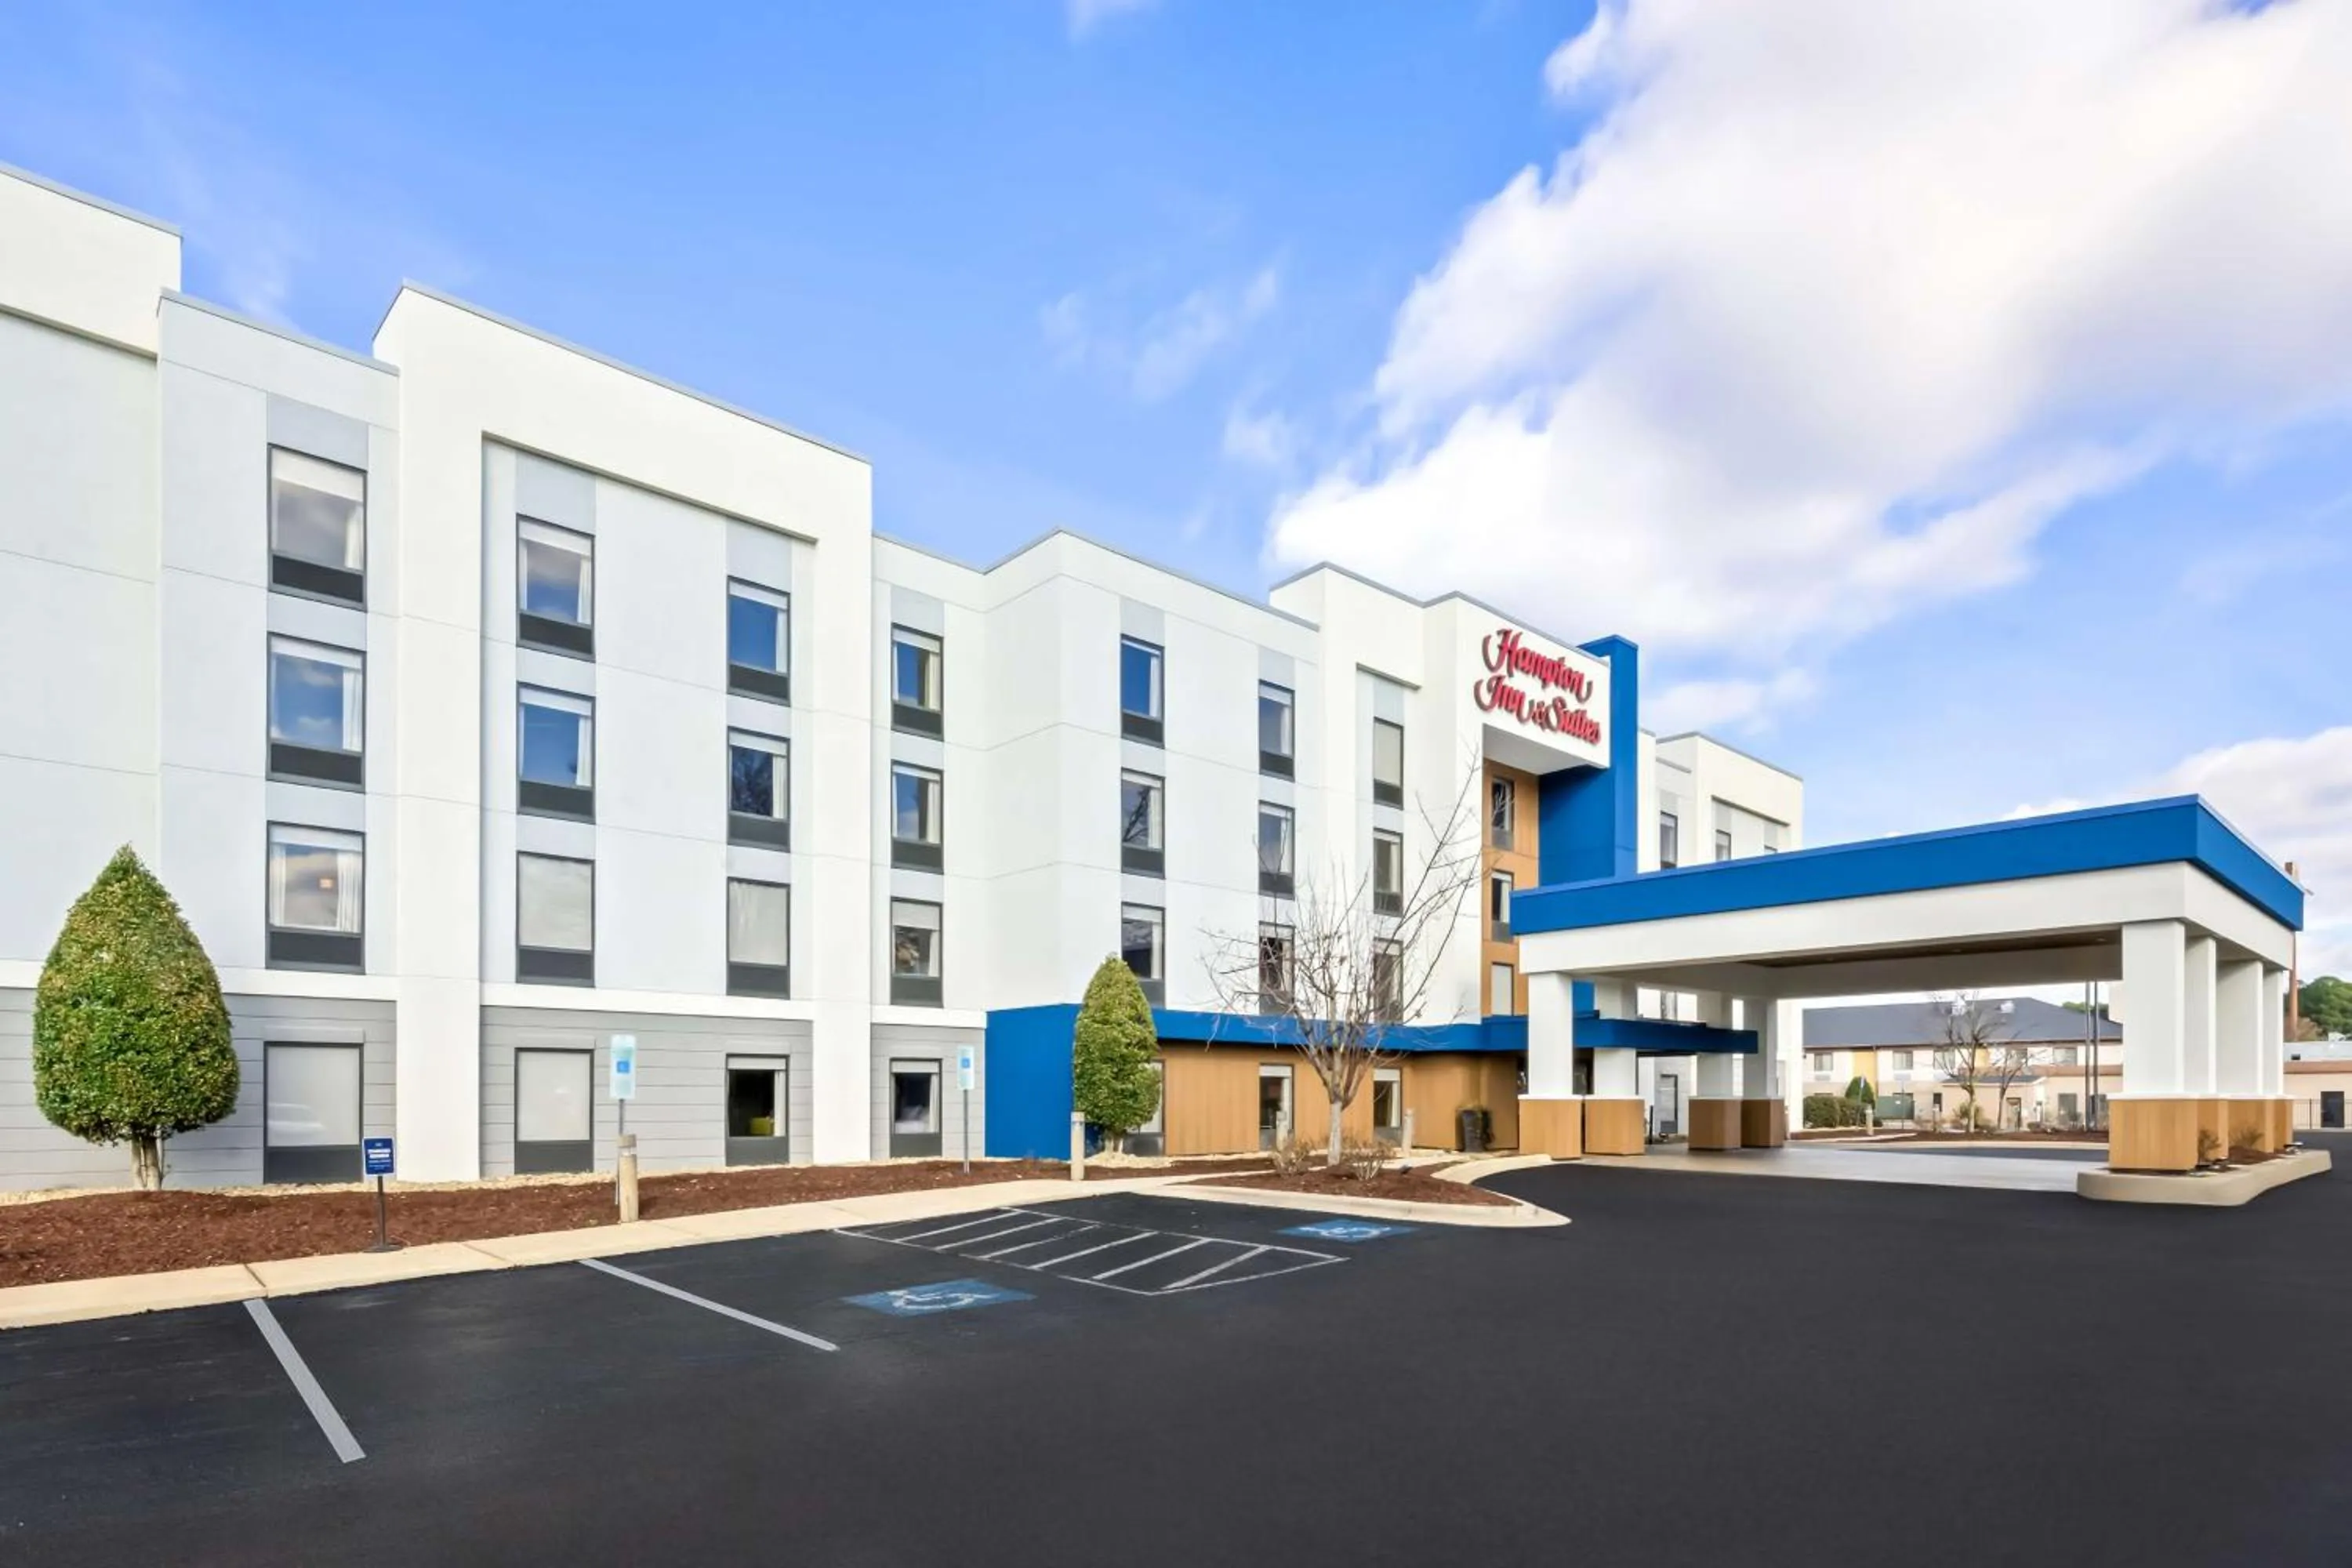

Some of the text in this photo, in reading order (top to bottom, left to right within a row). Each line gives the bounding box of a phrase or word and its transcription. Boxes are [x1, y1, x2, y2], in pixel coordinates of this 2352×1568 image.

[1482, 628, 1593, 704] Hampton
[1473, 674, 1601, 746] Inn & Suites
